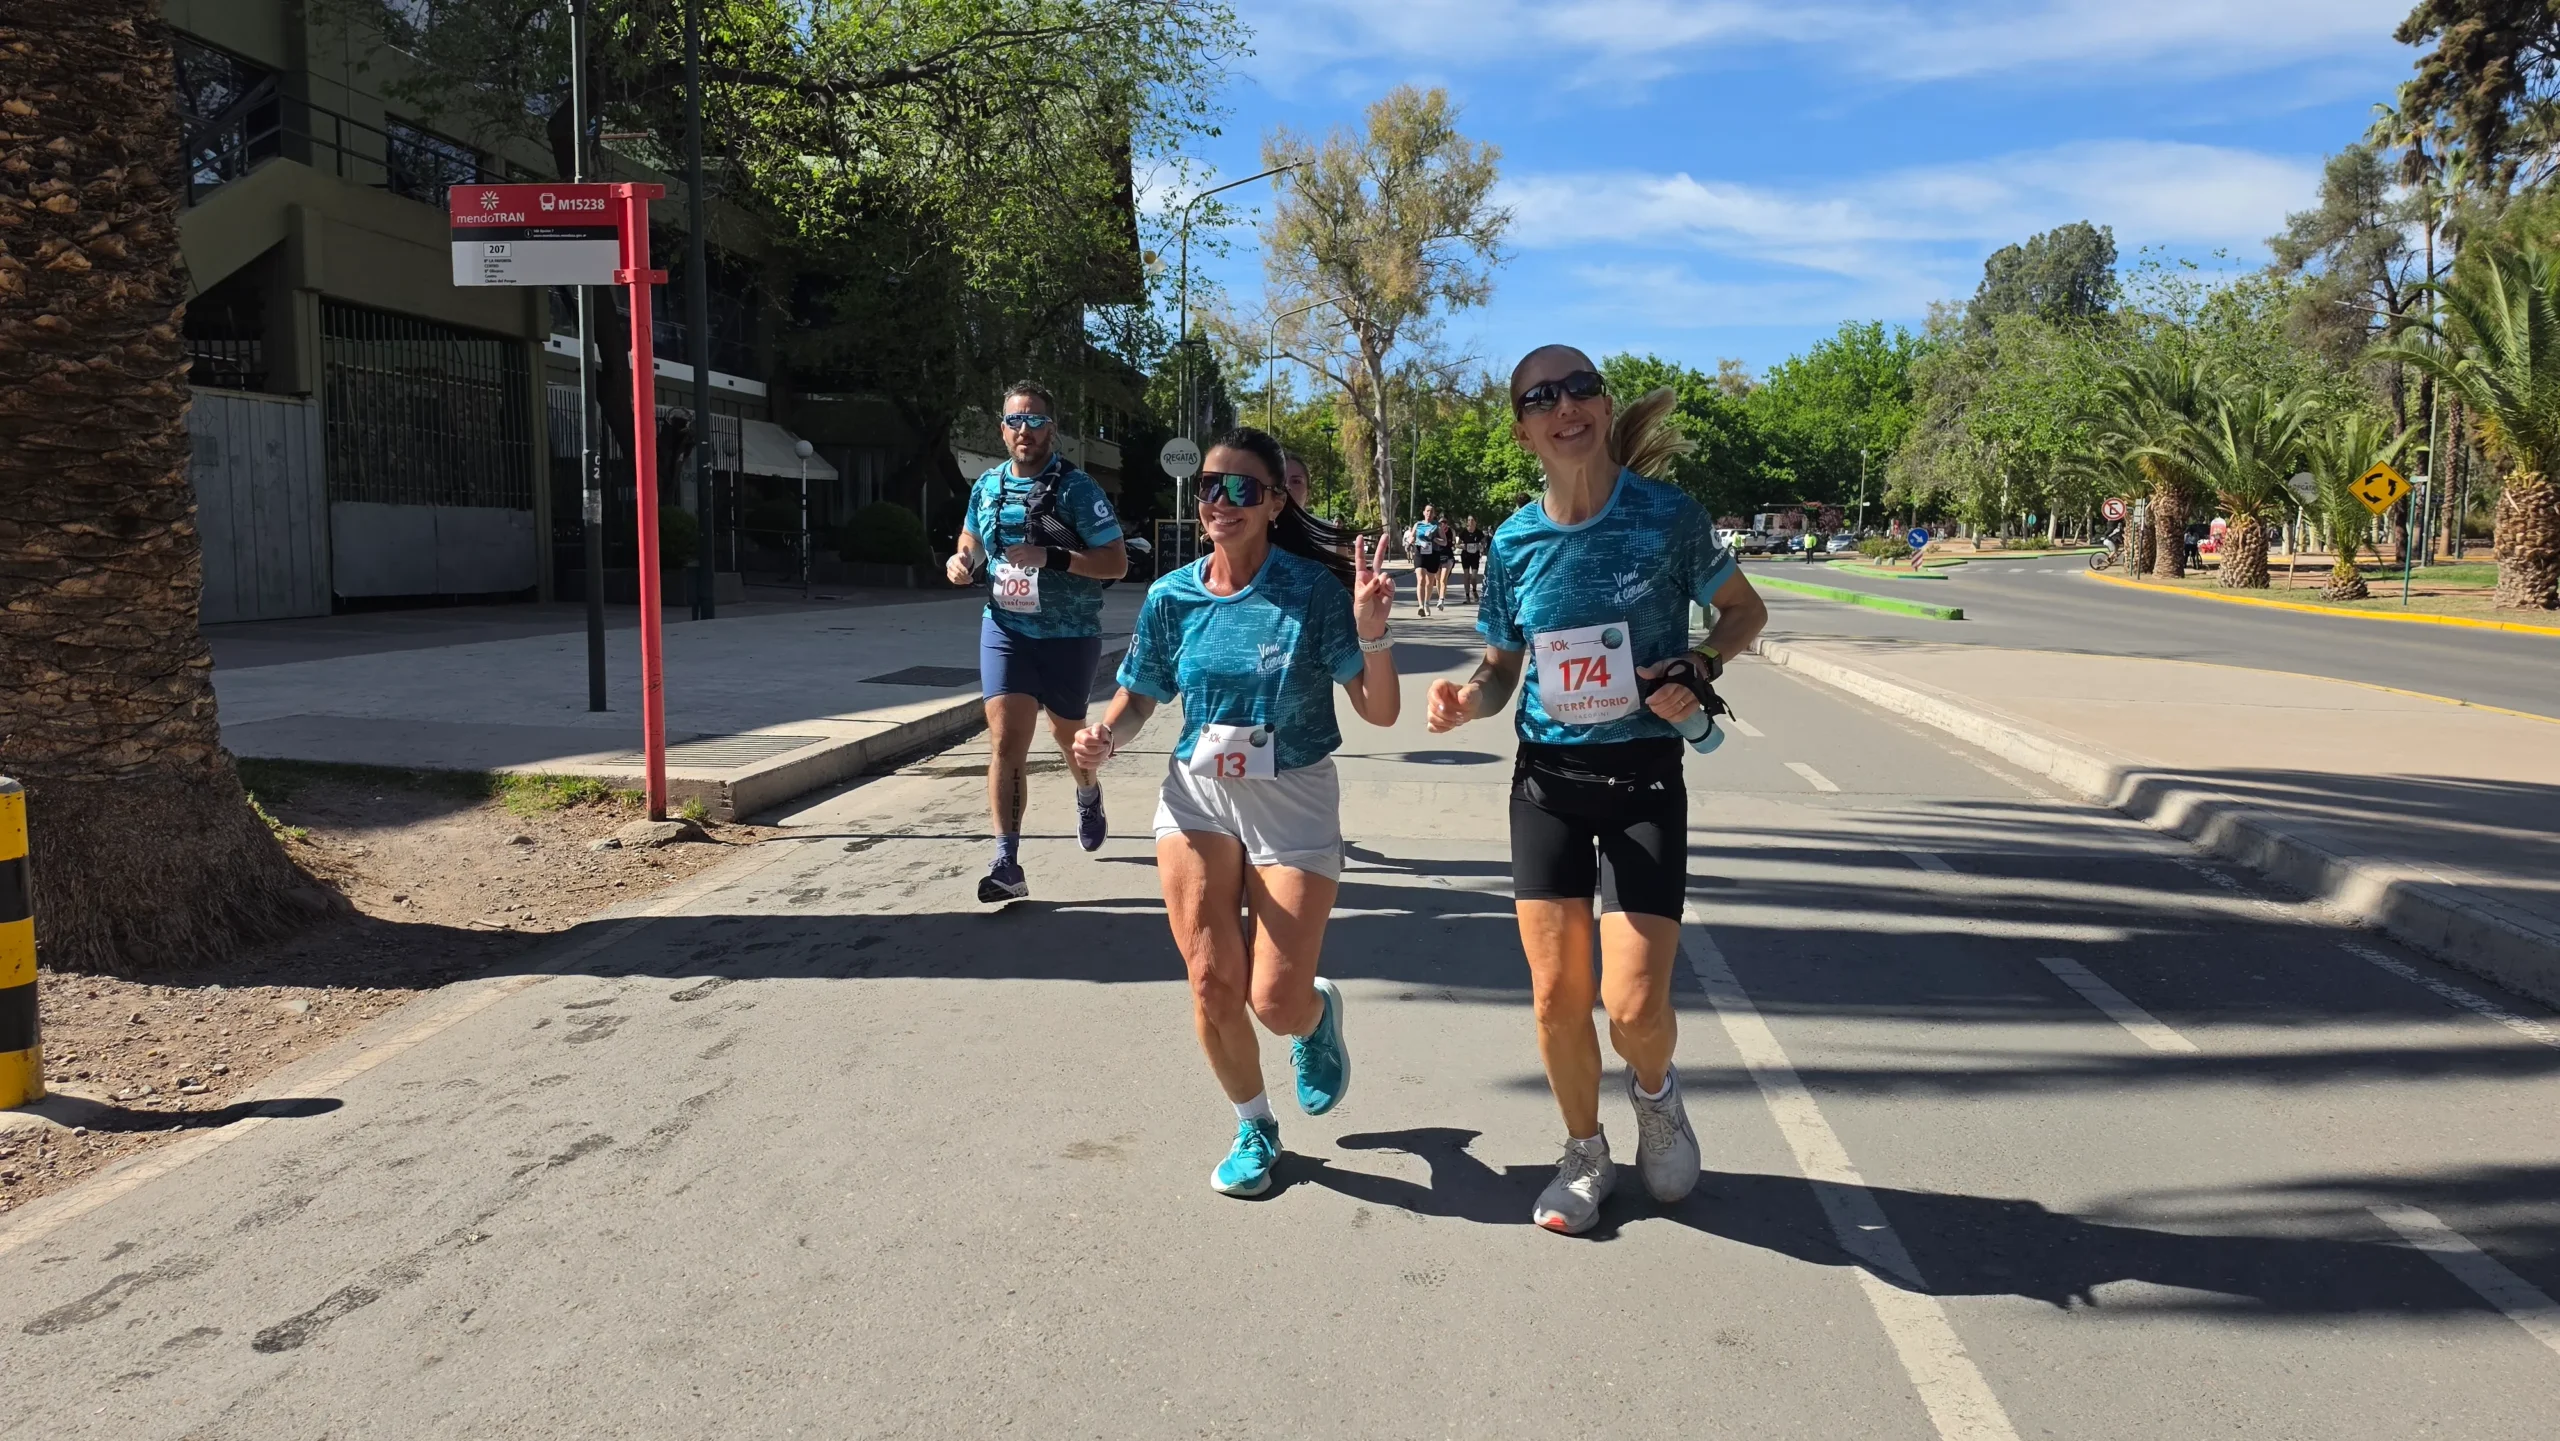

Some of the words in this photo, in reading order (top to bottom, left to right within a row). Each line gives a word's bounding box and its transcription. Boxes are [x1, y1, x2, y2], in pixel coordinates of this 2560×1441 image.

[558, 199, 605, 211] M15238
[456, 212, 525, 224] mendoTRAN
[489, 245, 505, 254] 207
[1163, 452, 1198, 465] REGATAS
[1000, 578, 1031, 596] 108
[1549, 640, 1570, 652] 10k
[1558, 655, 1612, 692] 174
[1556, 695, 1629, 712] TERRITORIO
[1213, 752, 1247, 778] 13
